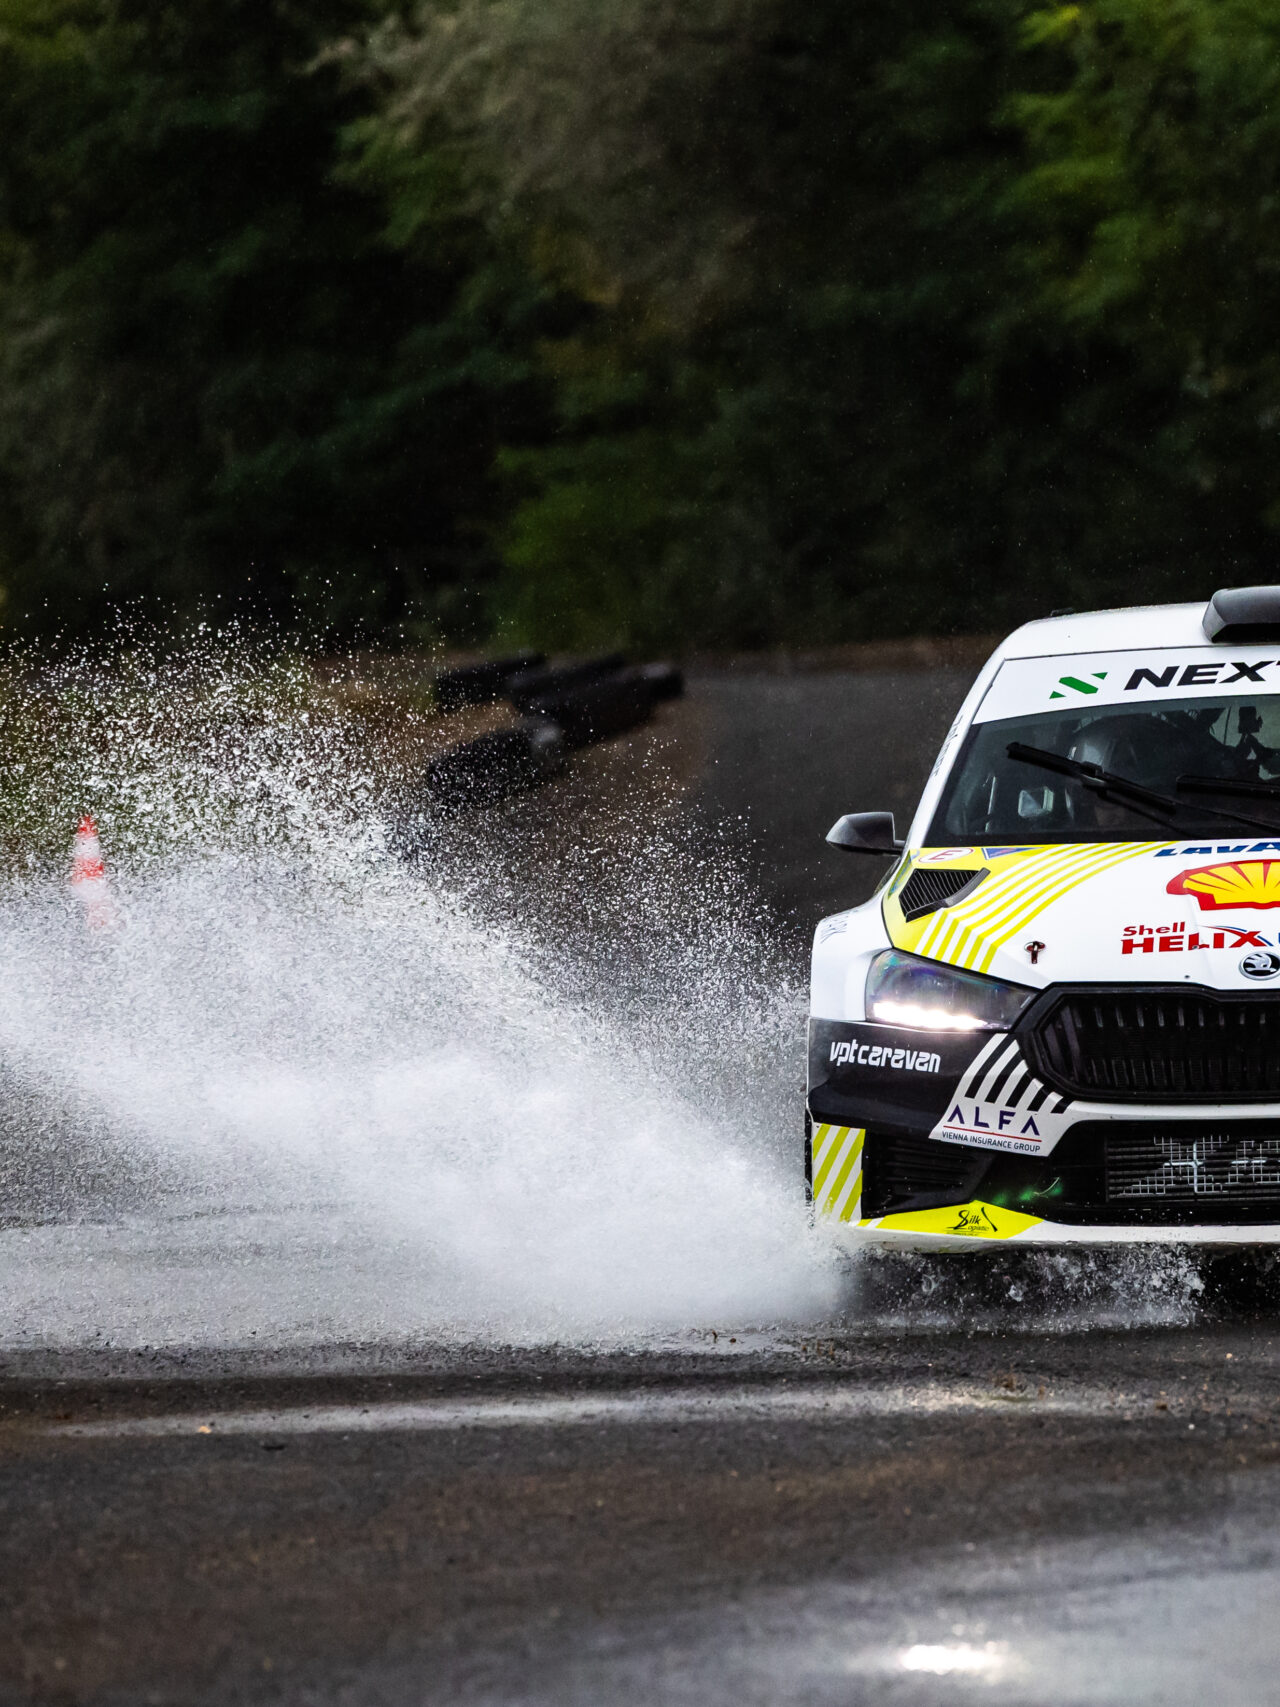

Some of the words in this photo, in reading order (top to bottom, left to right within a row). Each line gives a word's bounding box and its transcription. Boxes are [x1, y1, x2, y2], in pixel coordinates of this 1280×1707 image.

[1123, 921, 1185, 936] Shell
[1121, 930, 1267, 954] HELIX
[947, 1104, 1040, 1135] ALFA
[942, 1131, 968, 1142] VIENNA
[970, 1134, 1012, 1148] INSURANCE
[1013, 1141, 1040, 1152] GROUP
